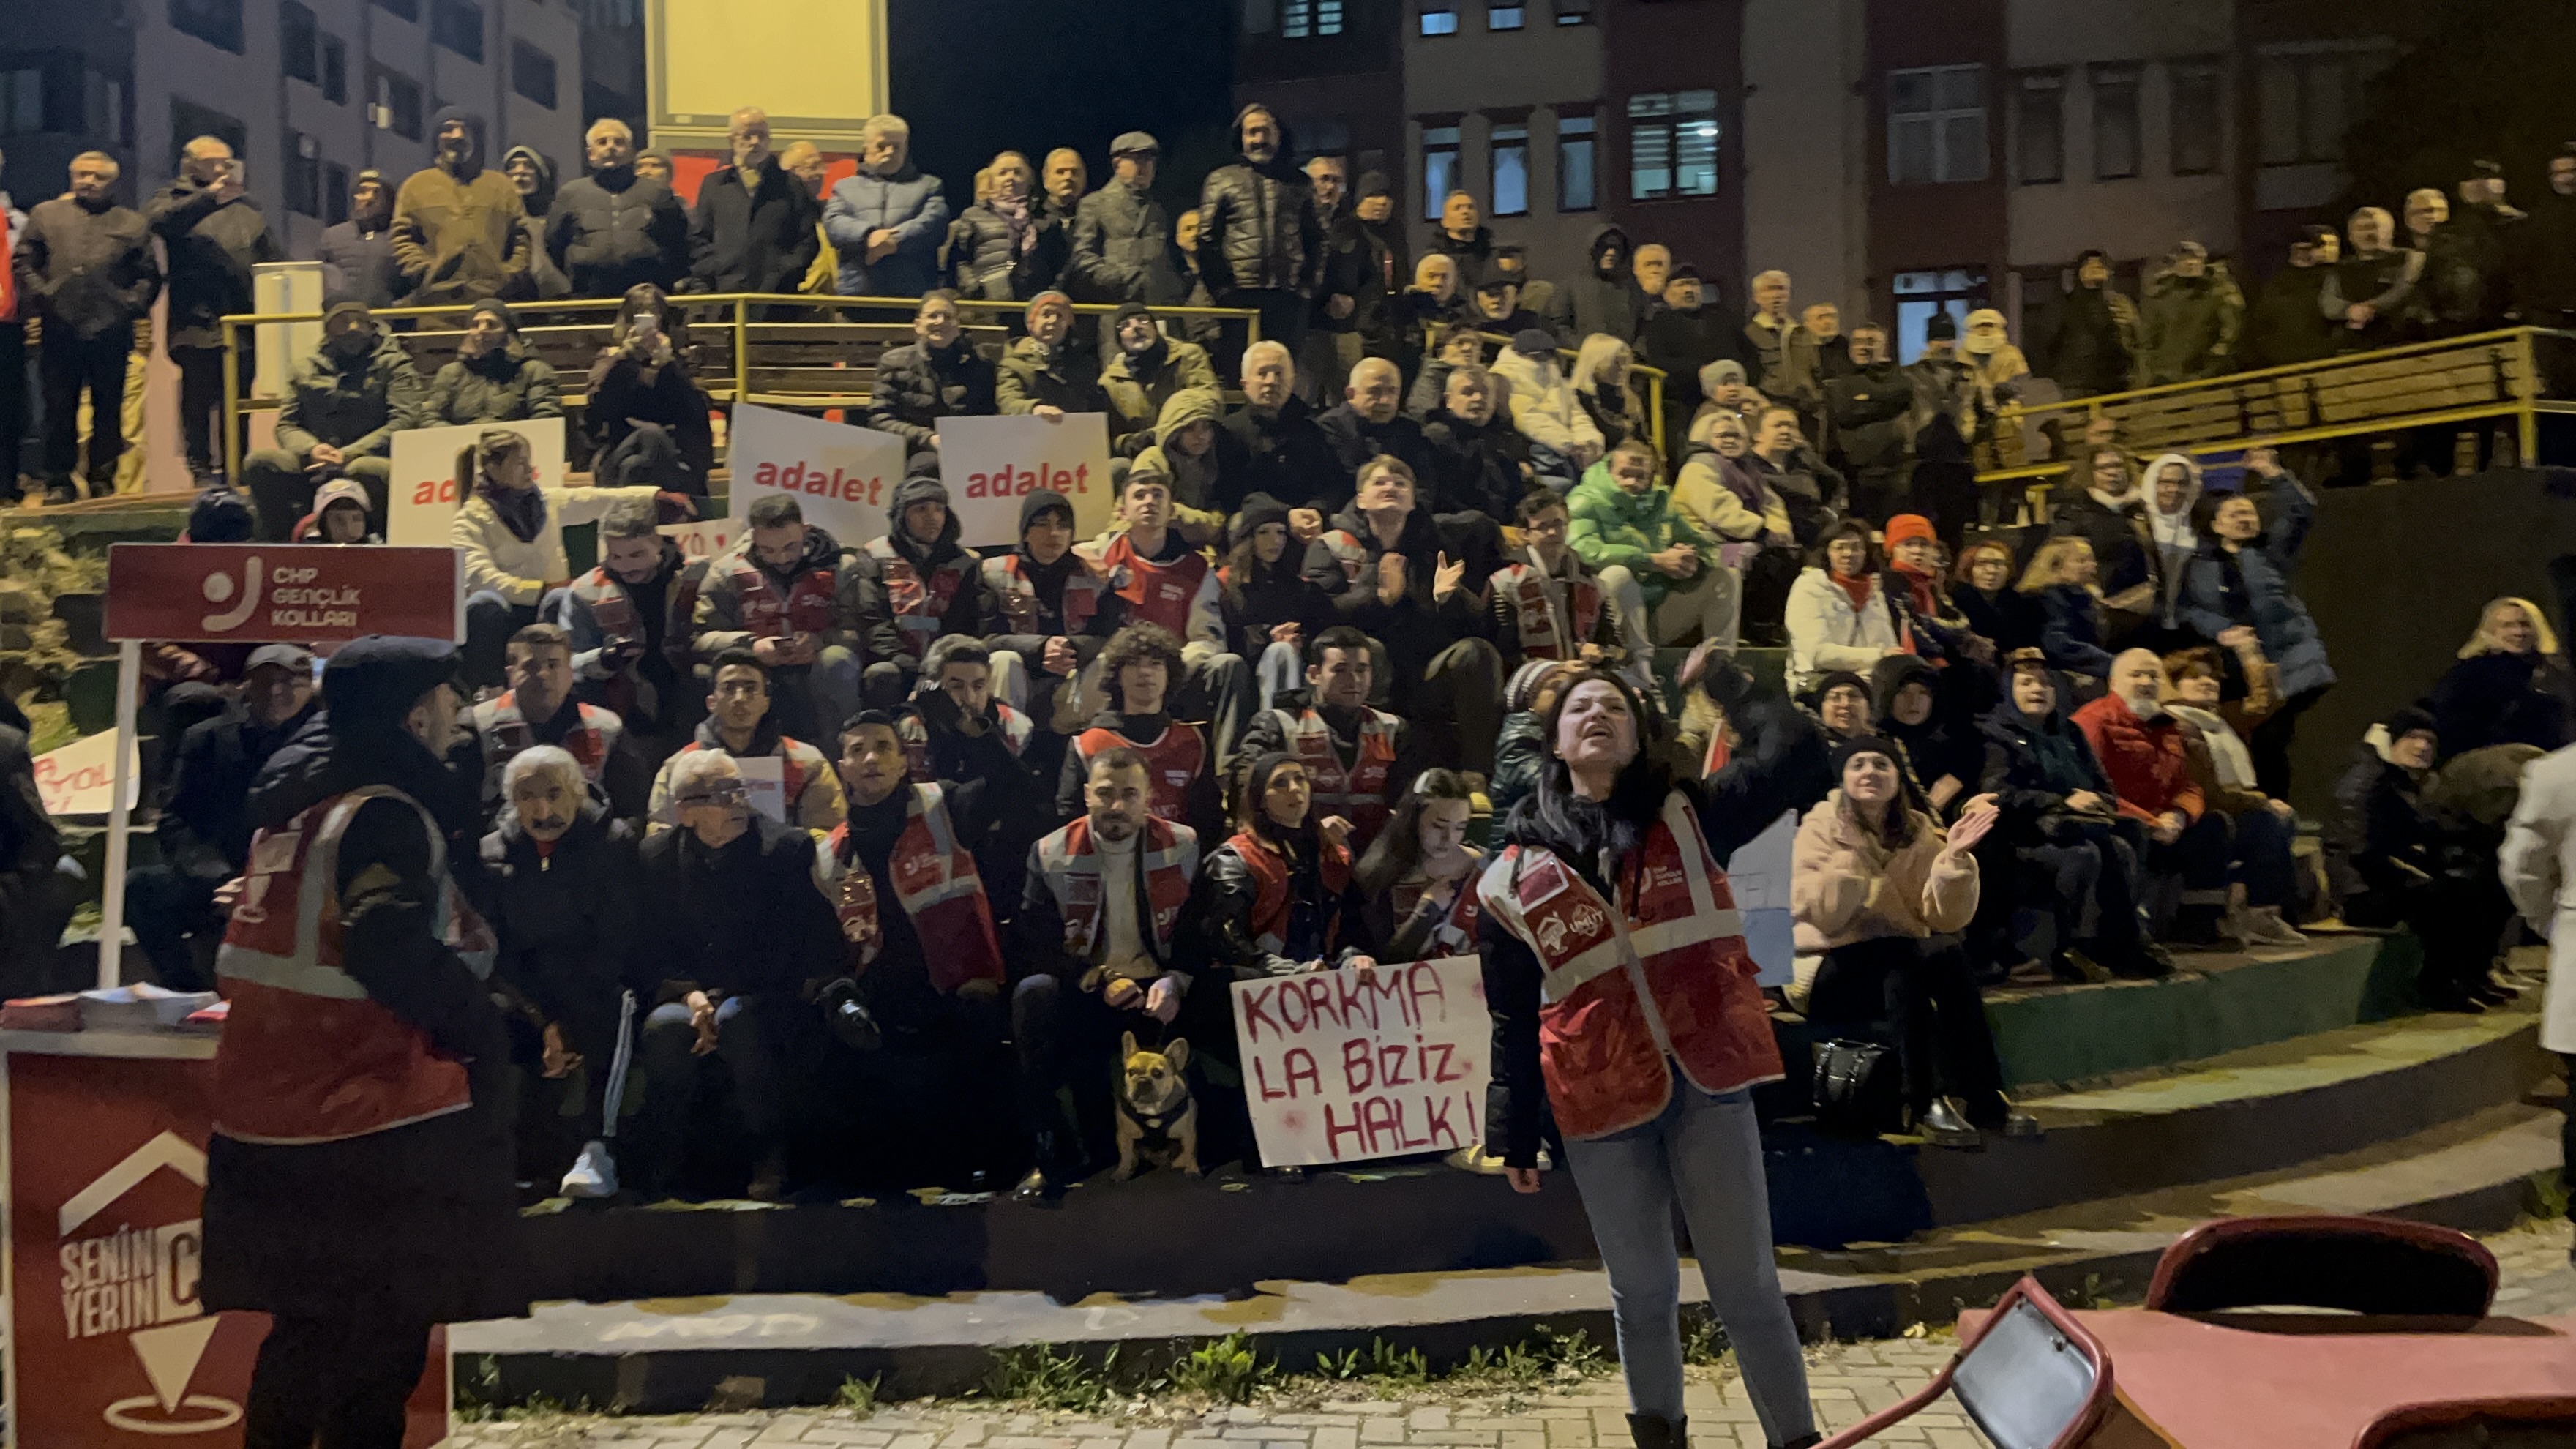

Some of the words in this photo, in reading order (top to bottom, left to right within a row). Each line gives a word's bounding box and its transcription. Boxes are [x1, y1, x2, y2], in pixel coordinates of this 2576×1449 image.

[754, 460, 883, 506] adalet
[966, 462, 1089, 498] adalet
[273, 566, 318, 584] CHP
[272, 584, 362, 610] GENÇLİK
[272, 609, 358, 628] KOLLARI
[1240, 961, 1446, 1044] KORKMA
[1254, 1046, 1323, 1103] LA
[59, 1222, 155, 1292] SENİN
